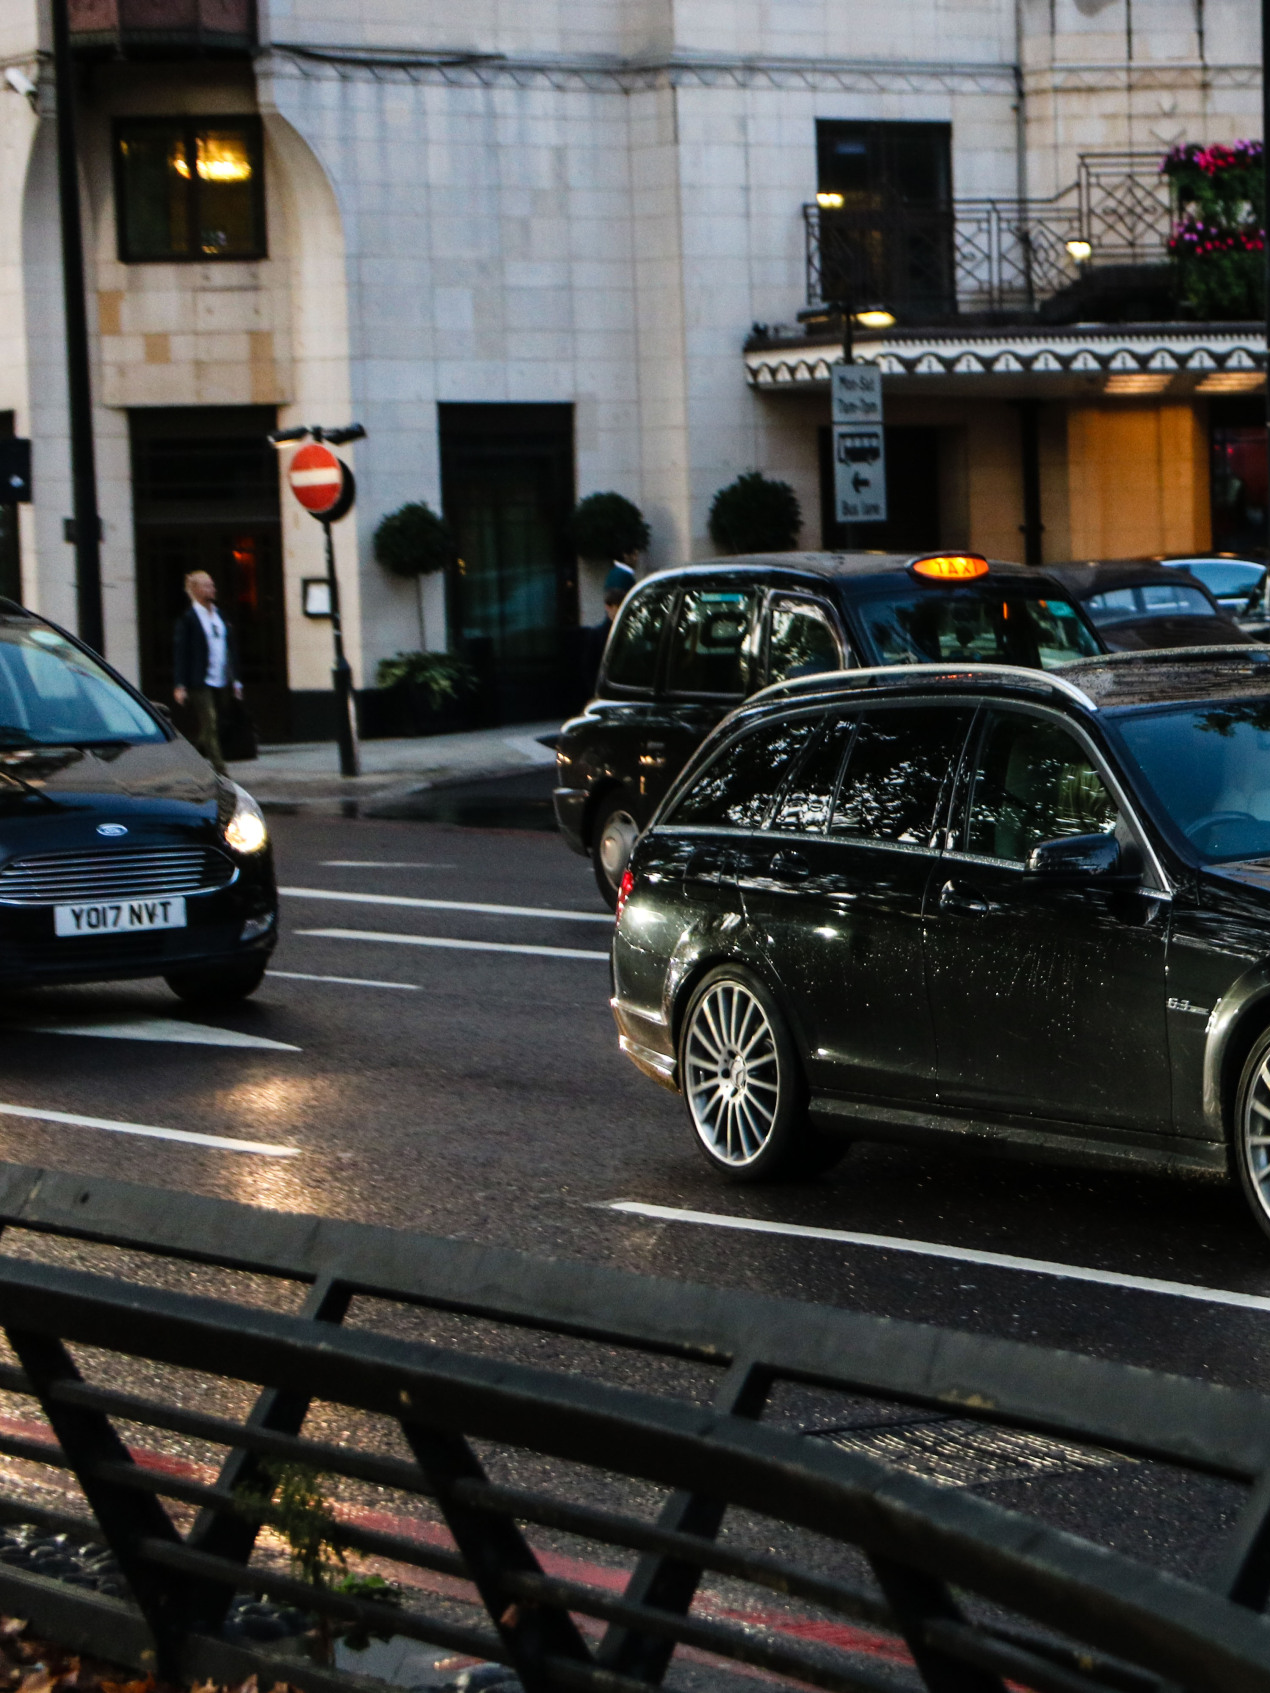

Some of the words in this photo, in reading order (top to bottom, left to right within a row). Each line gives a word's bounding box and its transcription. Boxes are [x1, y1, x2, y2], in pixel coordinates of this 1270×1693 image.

[935, 559, 979, 576] TAXI
[71, 905, 122, 930] YO17
[129, 901, 173, 926] NVT
